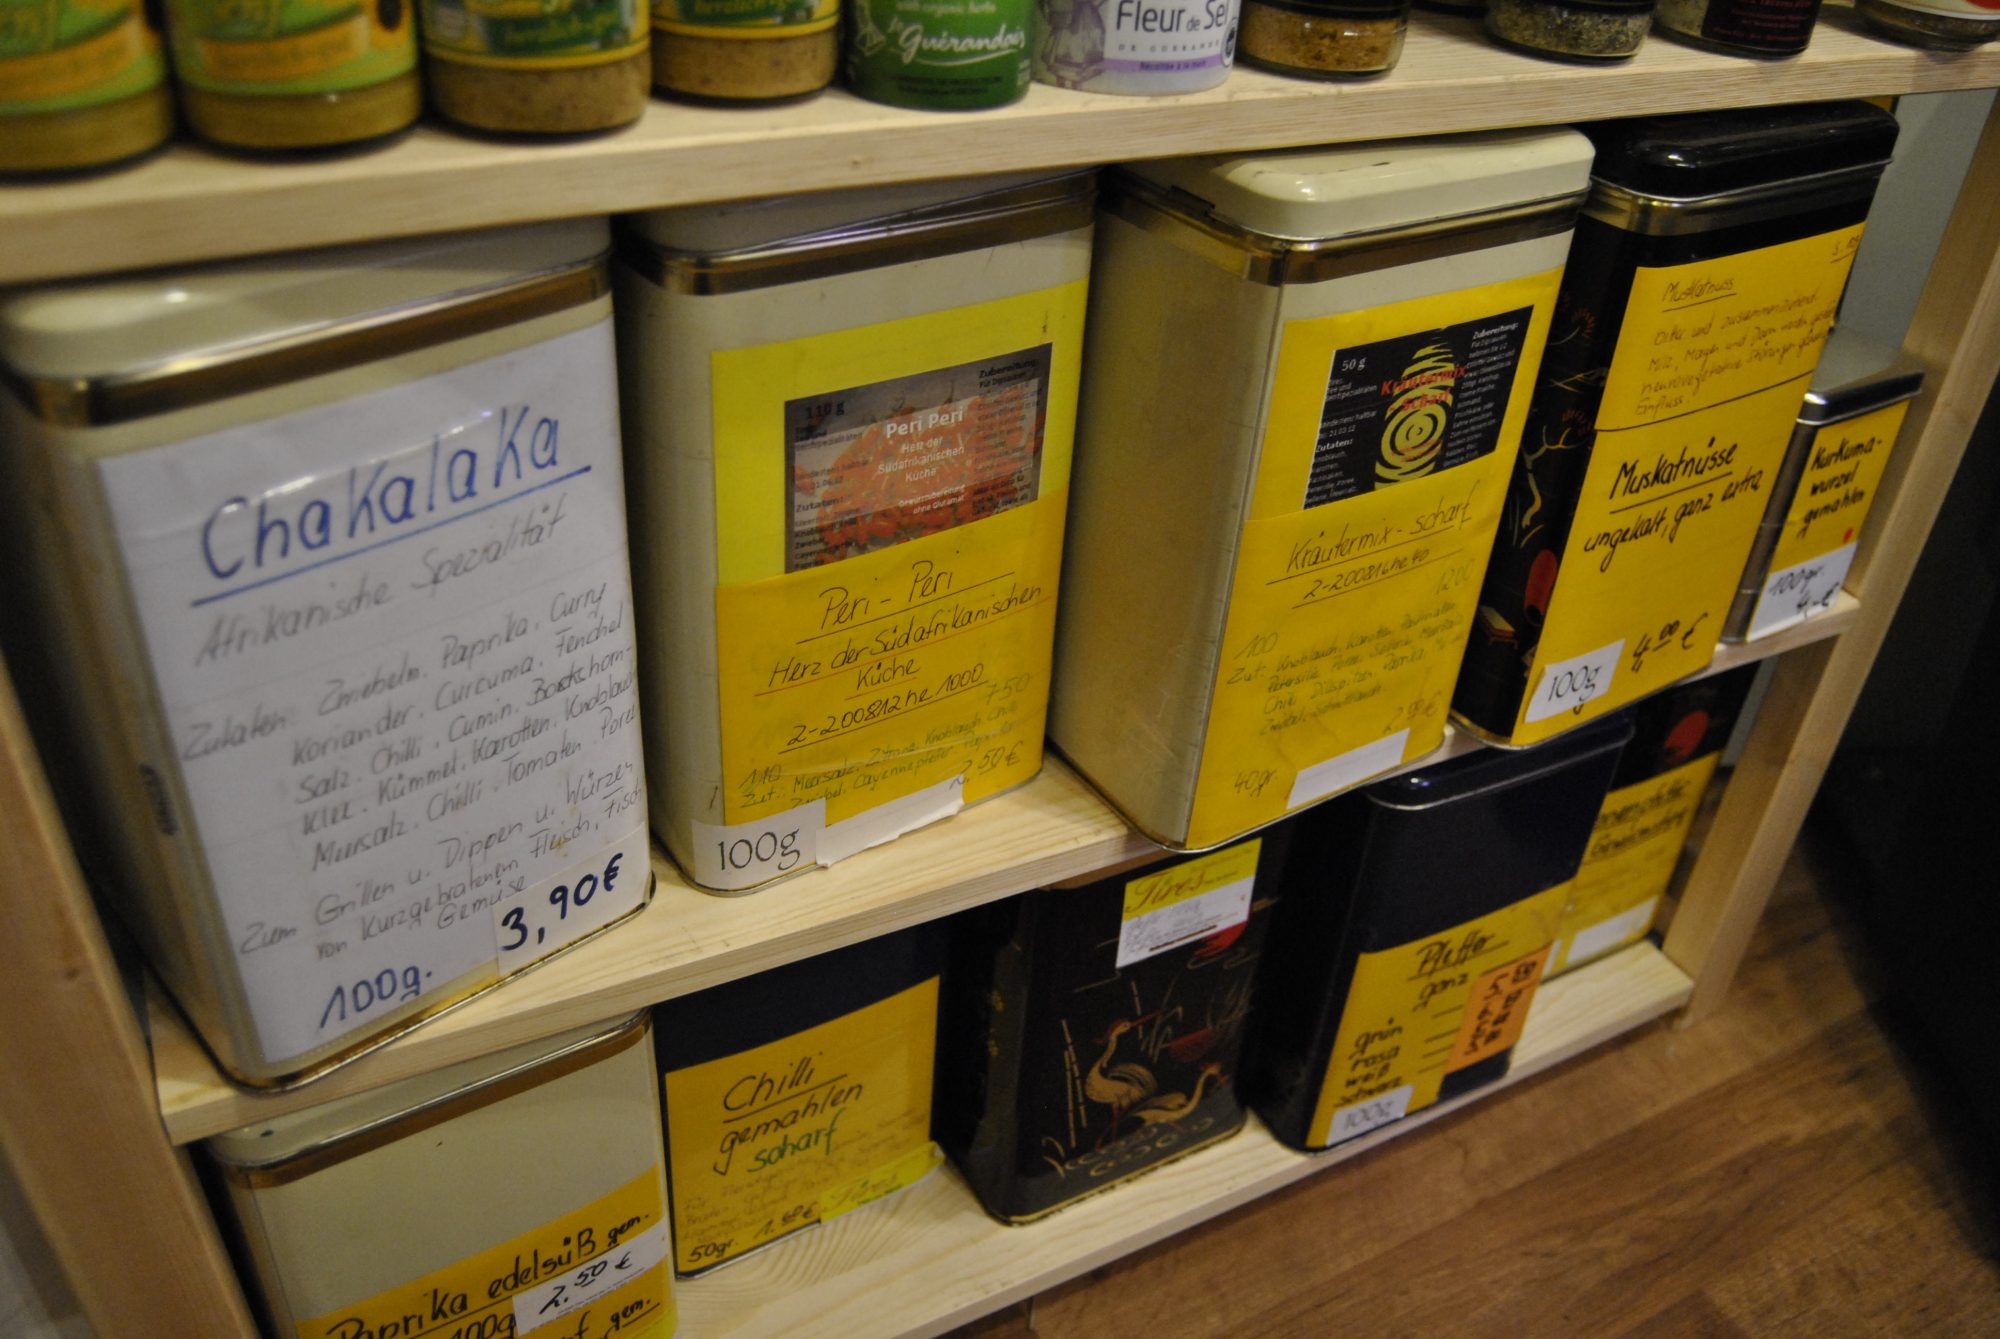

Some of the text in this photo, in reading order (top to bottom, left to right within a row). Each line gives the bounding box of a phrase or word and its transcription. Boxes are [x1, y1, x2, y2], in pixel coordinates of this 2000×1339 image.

[1115, 0, 1228, 33] Fleur de Sel
[1341, 359, 1356, 372] 50
[886, 418, 923, 439] Peri
[928, 406, 964, 430] Peri
[1609, 436, 1738, 500] Muskatnüsse
[1809, 460, 1860, 497] wurzel
[1796, 487, 1866, 539] gemahlen
[818, 586, 870, 629] Peri
[907, 561, 953, 603] Peri
[768, 660, 822, 688] Herz
[856, 657, 921, 691] Küche
[1548, 665, 1602, 716] 100g
[717, 826, 801, 872] 100g
[1412, 973, 1469, 1013] ganz
[723, 1050, 823, 1112] Chilli
[712, 1082, 864, 1177] gemahlen
[746, 1106, 848, 1173] scharf
